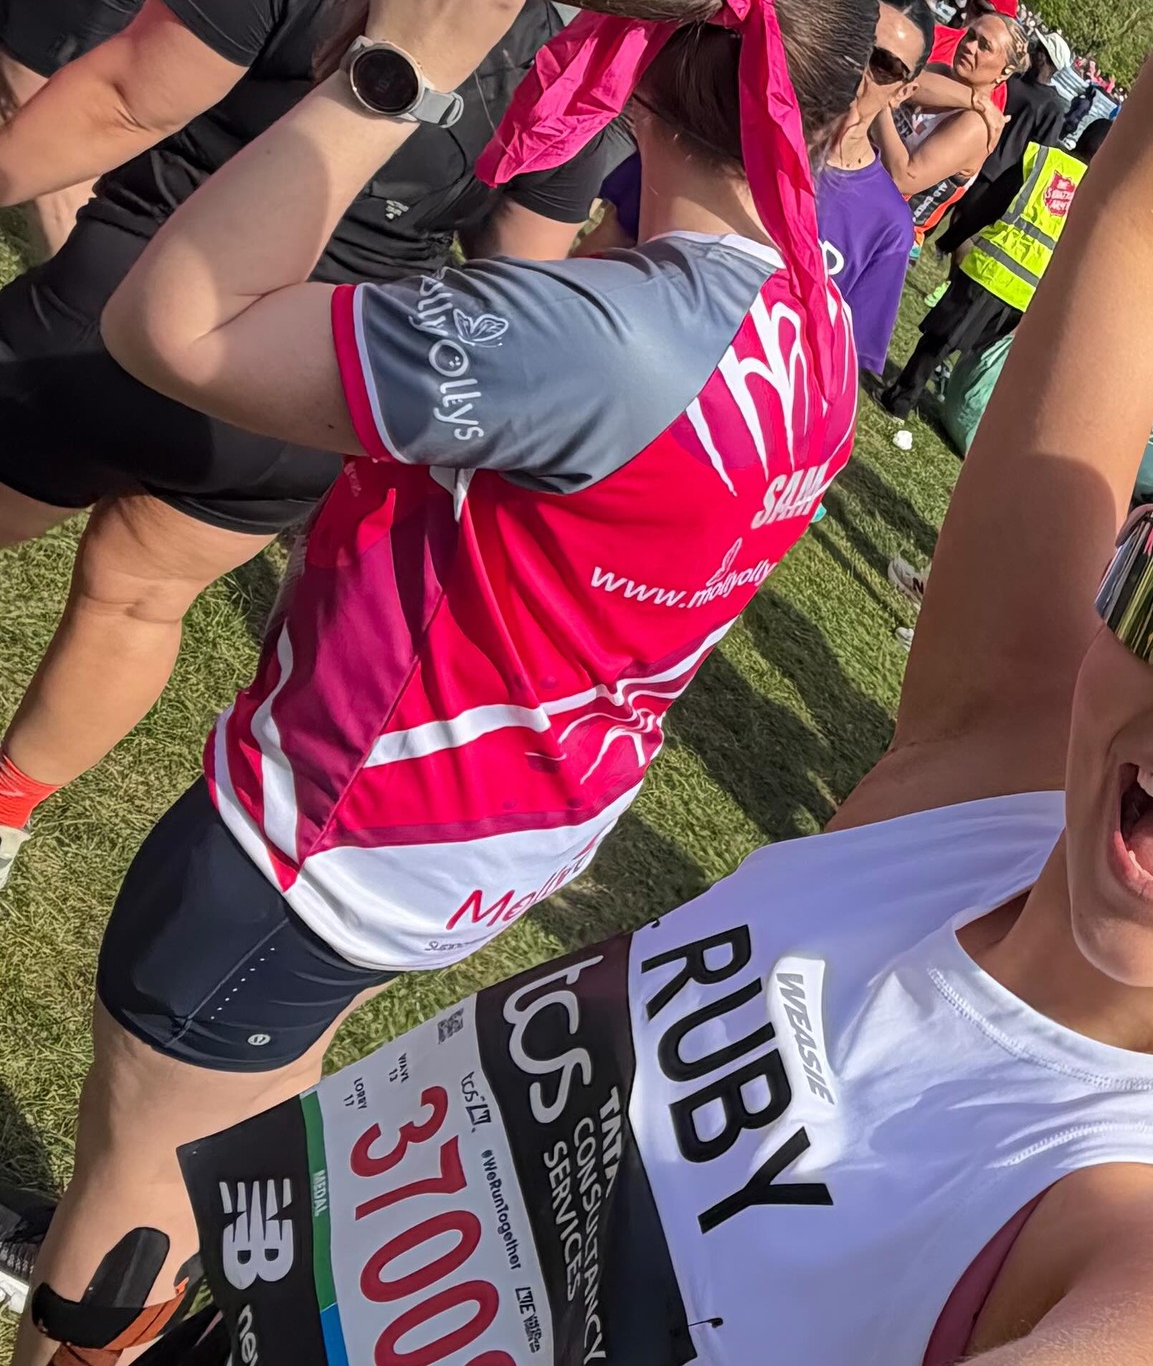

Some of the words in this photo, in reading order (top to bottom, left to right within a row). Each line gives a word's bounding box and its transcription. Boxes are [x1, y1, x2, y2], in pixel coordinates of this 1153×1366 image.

[343, 1094, 355, 1107] 17
[353, 1077, 368, 1110] LORRY
[503, 954, 604, 1124] tcs
[641, 924, 834, 1235] RUBY
[776, 973, 835, 1106] WEASIE
[313, 1169, 328, 1217] MEDAL
[543, 1140, 583, 1302] SERVICES
[573, 1117, 607, 1366] CONSULTANCY
